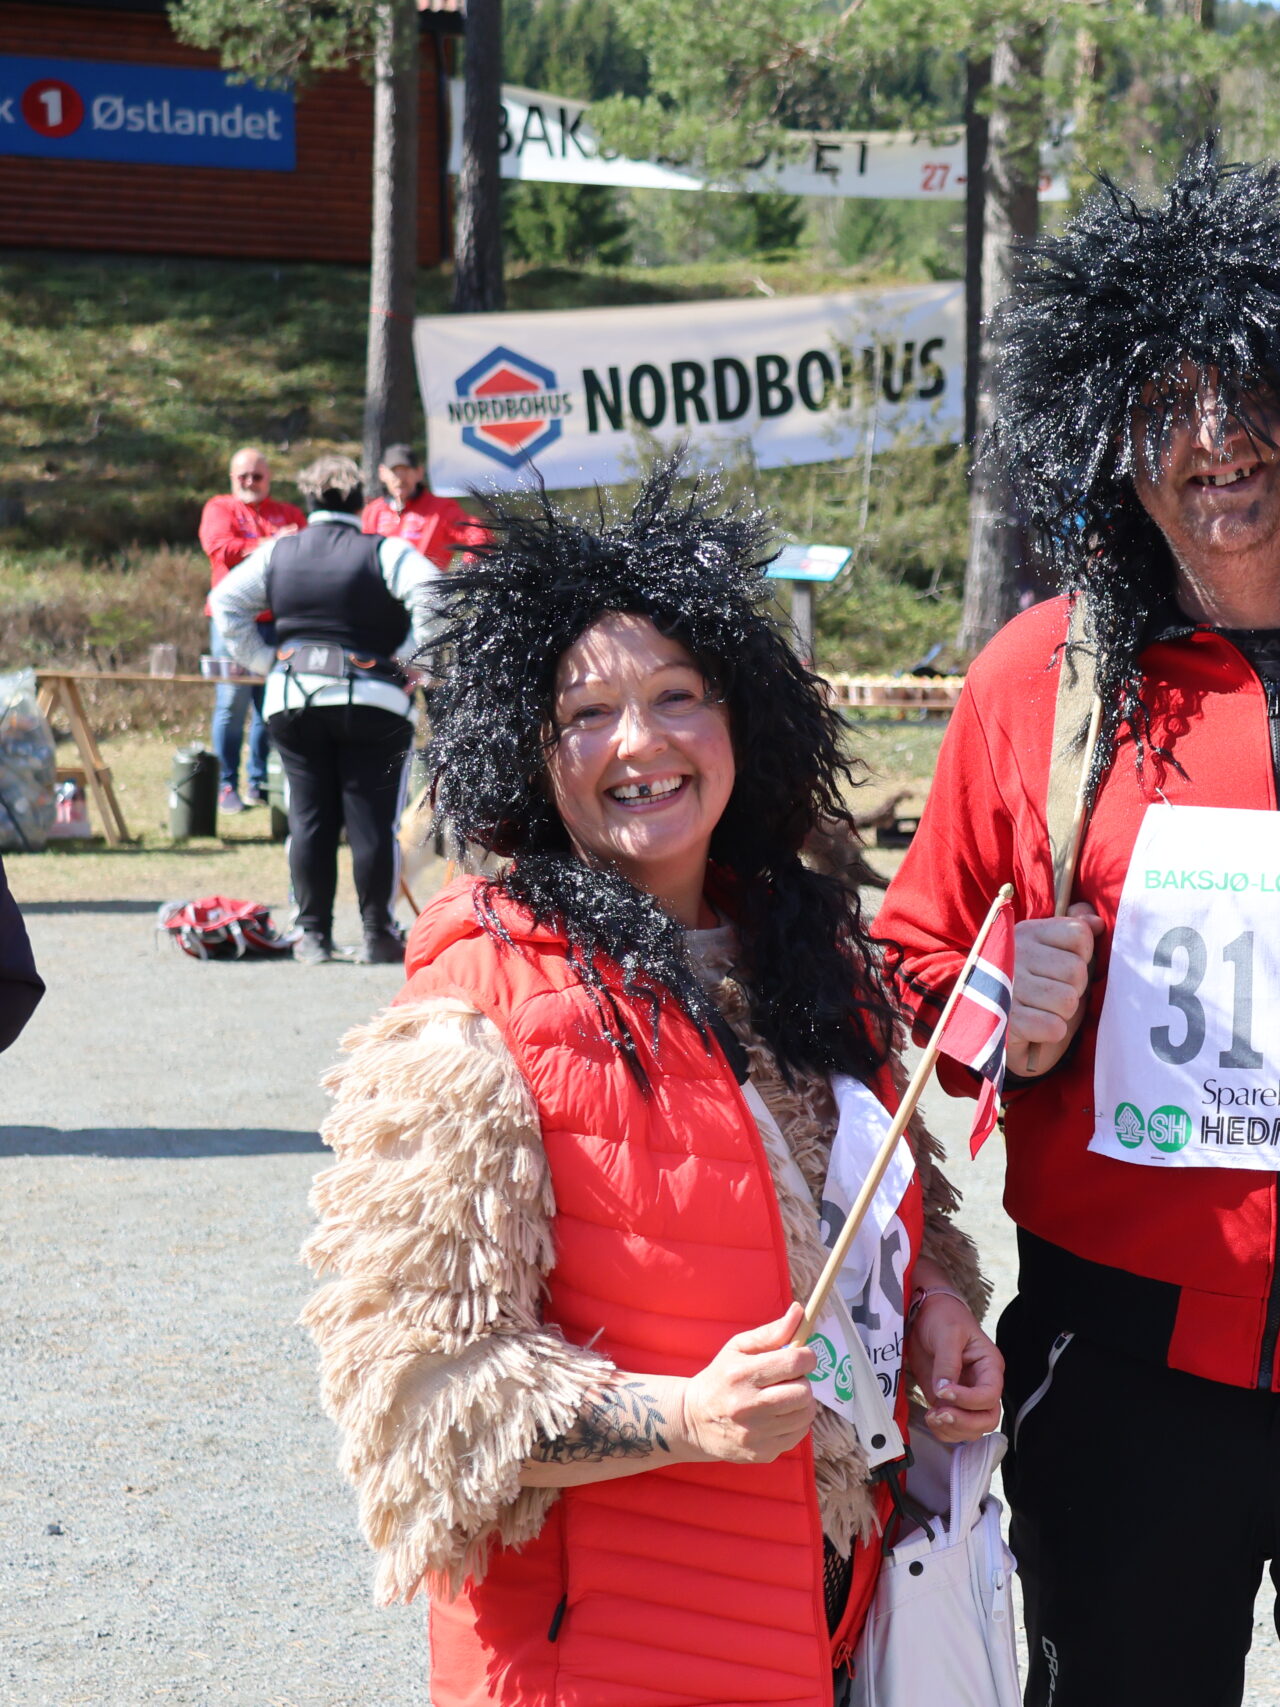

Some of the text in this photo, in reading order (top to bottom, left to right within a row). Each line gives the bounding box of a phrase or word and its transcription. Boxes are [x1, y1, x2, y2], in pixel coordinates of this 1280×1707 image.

[39, 88, 63, 128] 1
[92, 95, 282, 141] Østlandet
[448, 393, 573, 423] NORDBOHUS
[1150, 1113, 1187, 1144] SH
